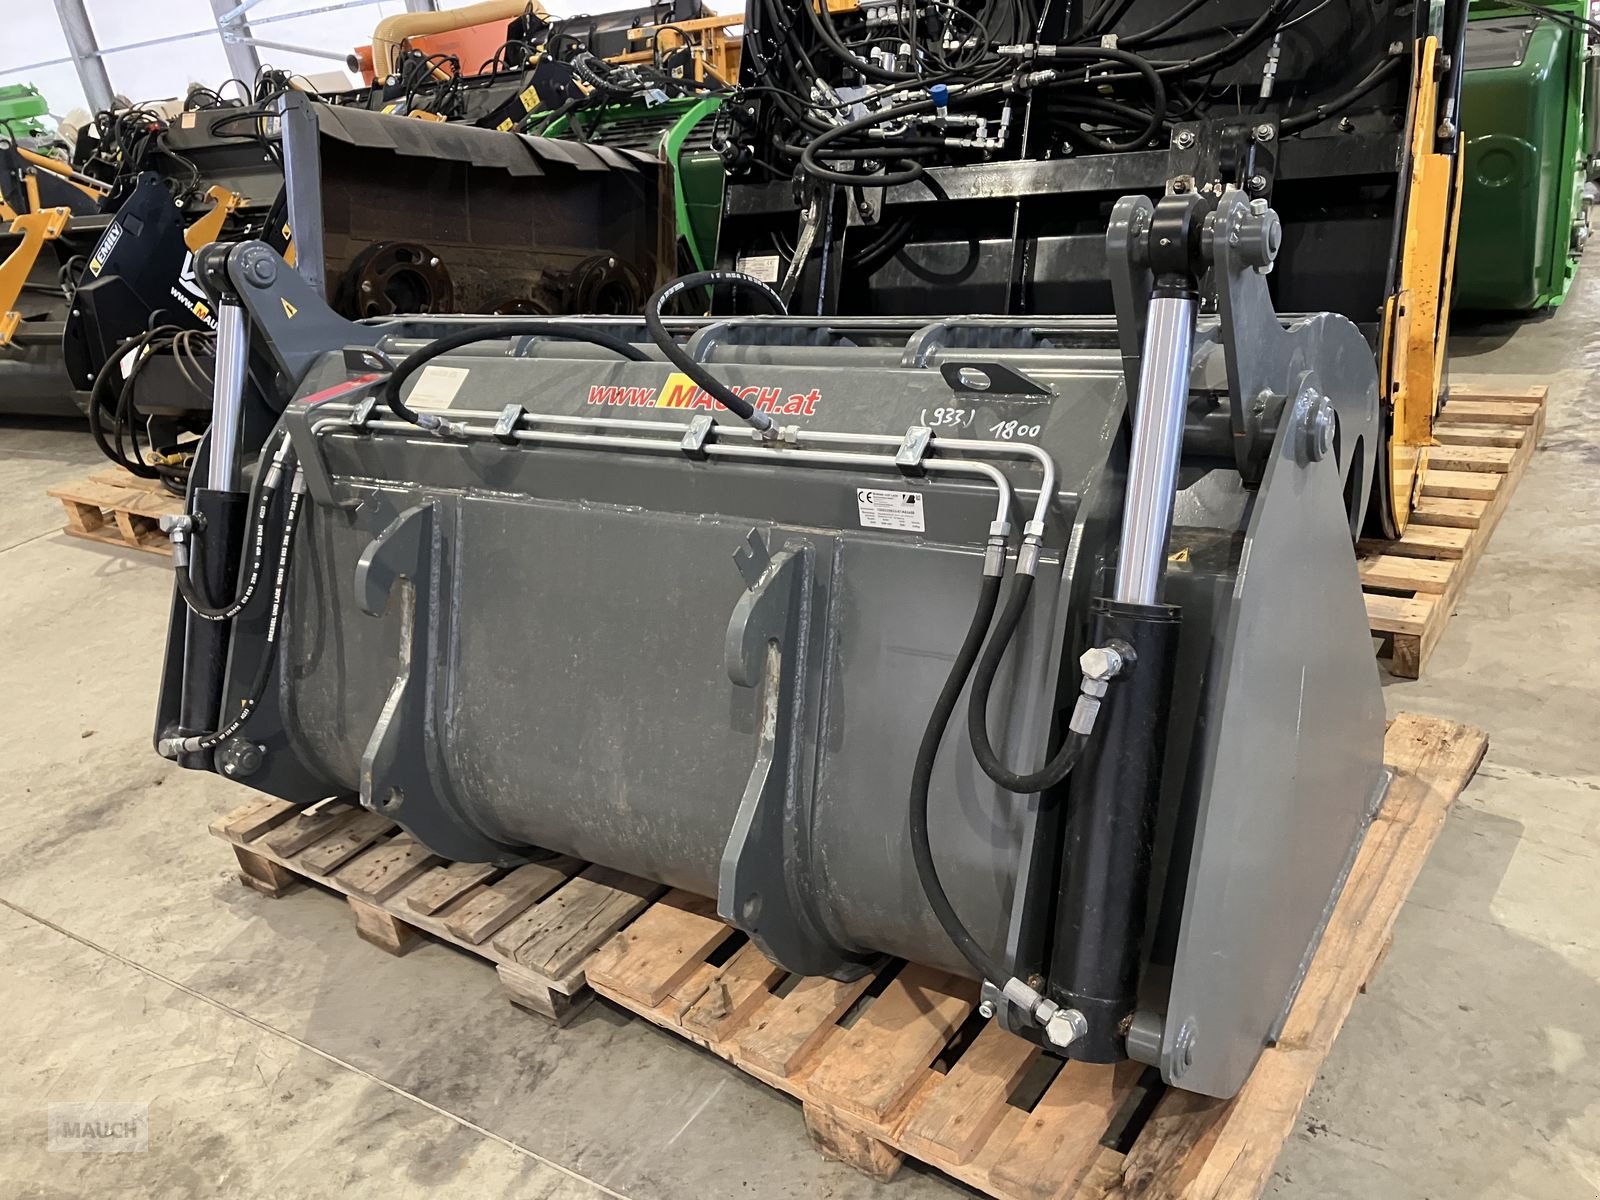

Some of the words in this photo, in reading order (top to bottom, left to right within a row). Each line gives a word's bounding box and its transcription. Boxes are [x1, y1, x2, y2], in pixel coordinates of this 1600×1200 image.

[96, 224, 121, 264] EMILY
[170, 286, 218, 330] www.MAU
[989, 420, 1040, 439] 1800
